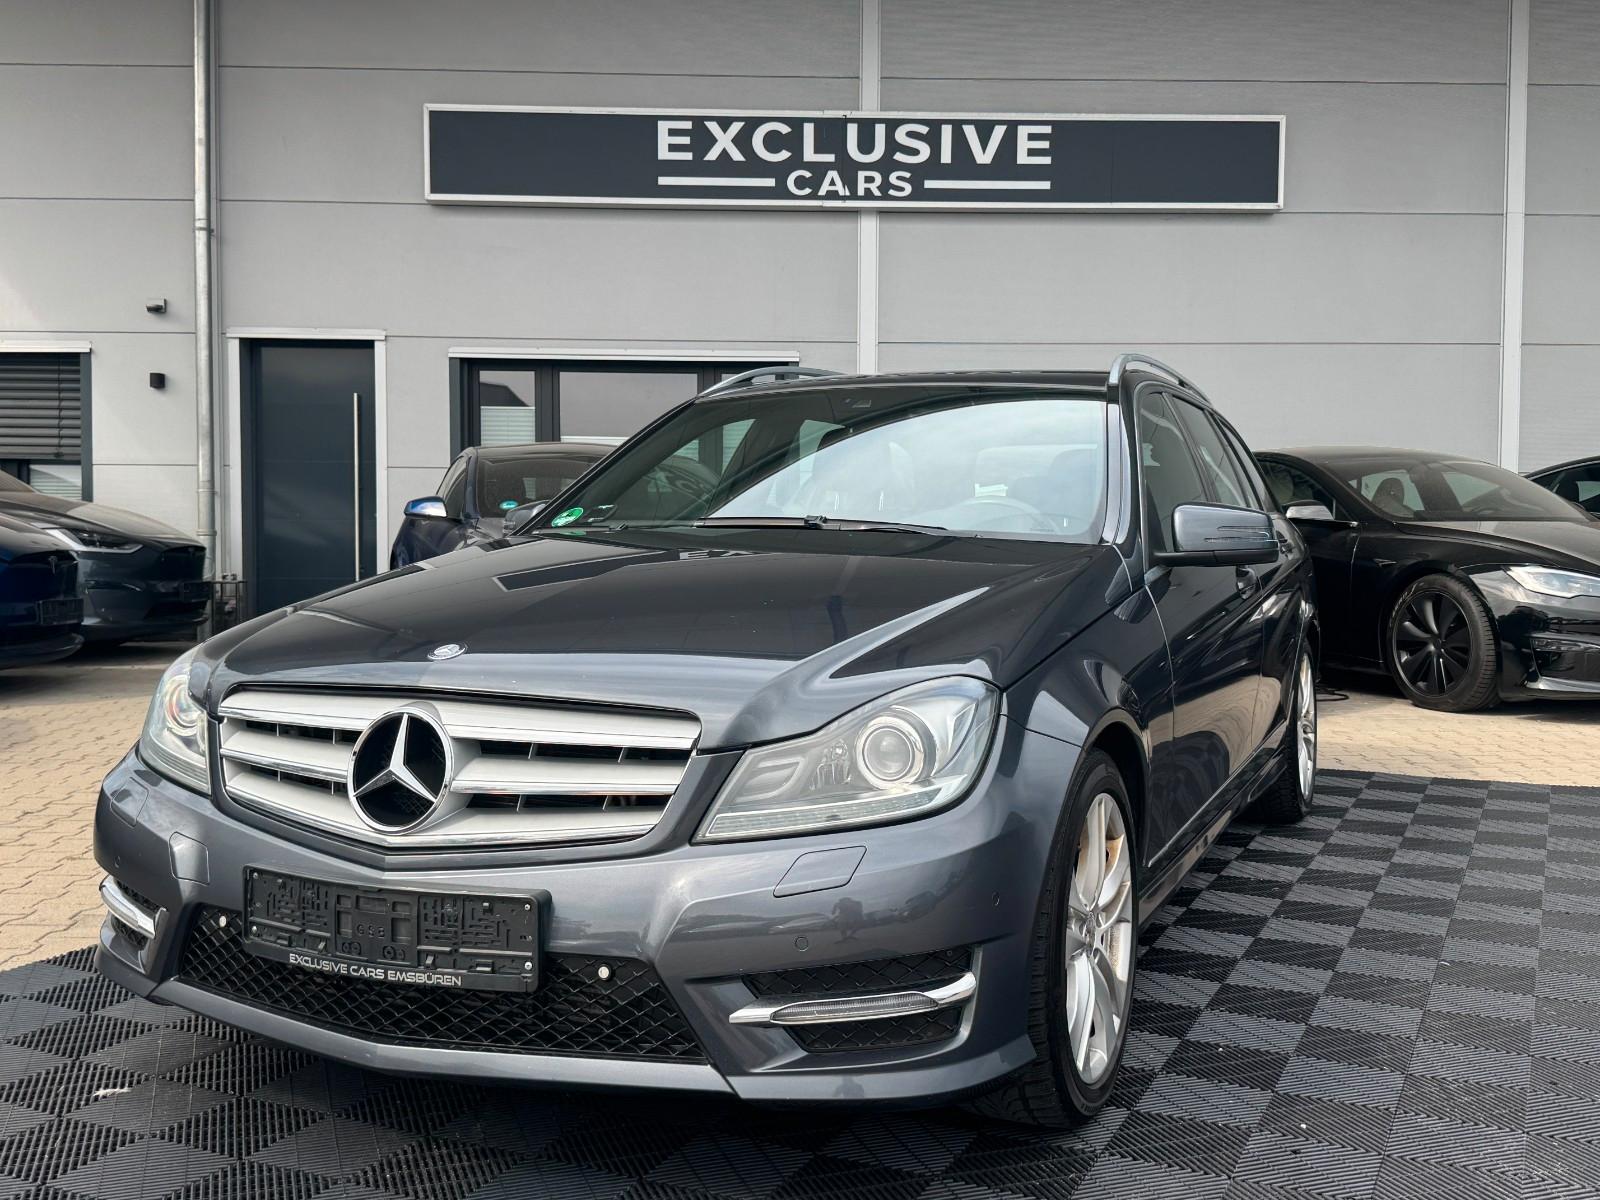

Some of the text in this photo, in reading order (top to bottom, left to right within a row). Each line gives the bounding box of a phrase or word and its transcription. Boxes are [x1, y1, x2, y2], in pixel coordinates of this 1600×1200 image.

[657, 120, 1052, 165] EXCLUSIVE
[786, 169, 913, 197] CARS
[289, 953, 462, 986] EXCLUSIVE CARS EMSBÜREN
